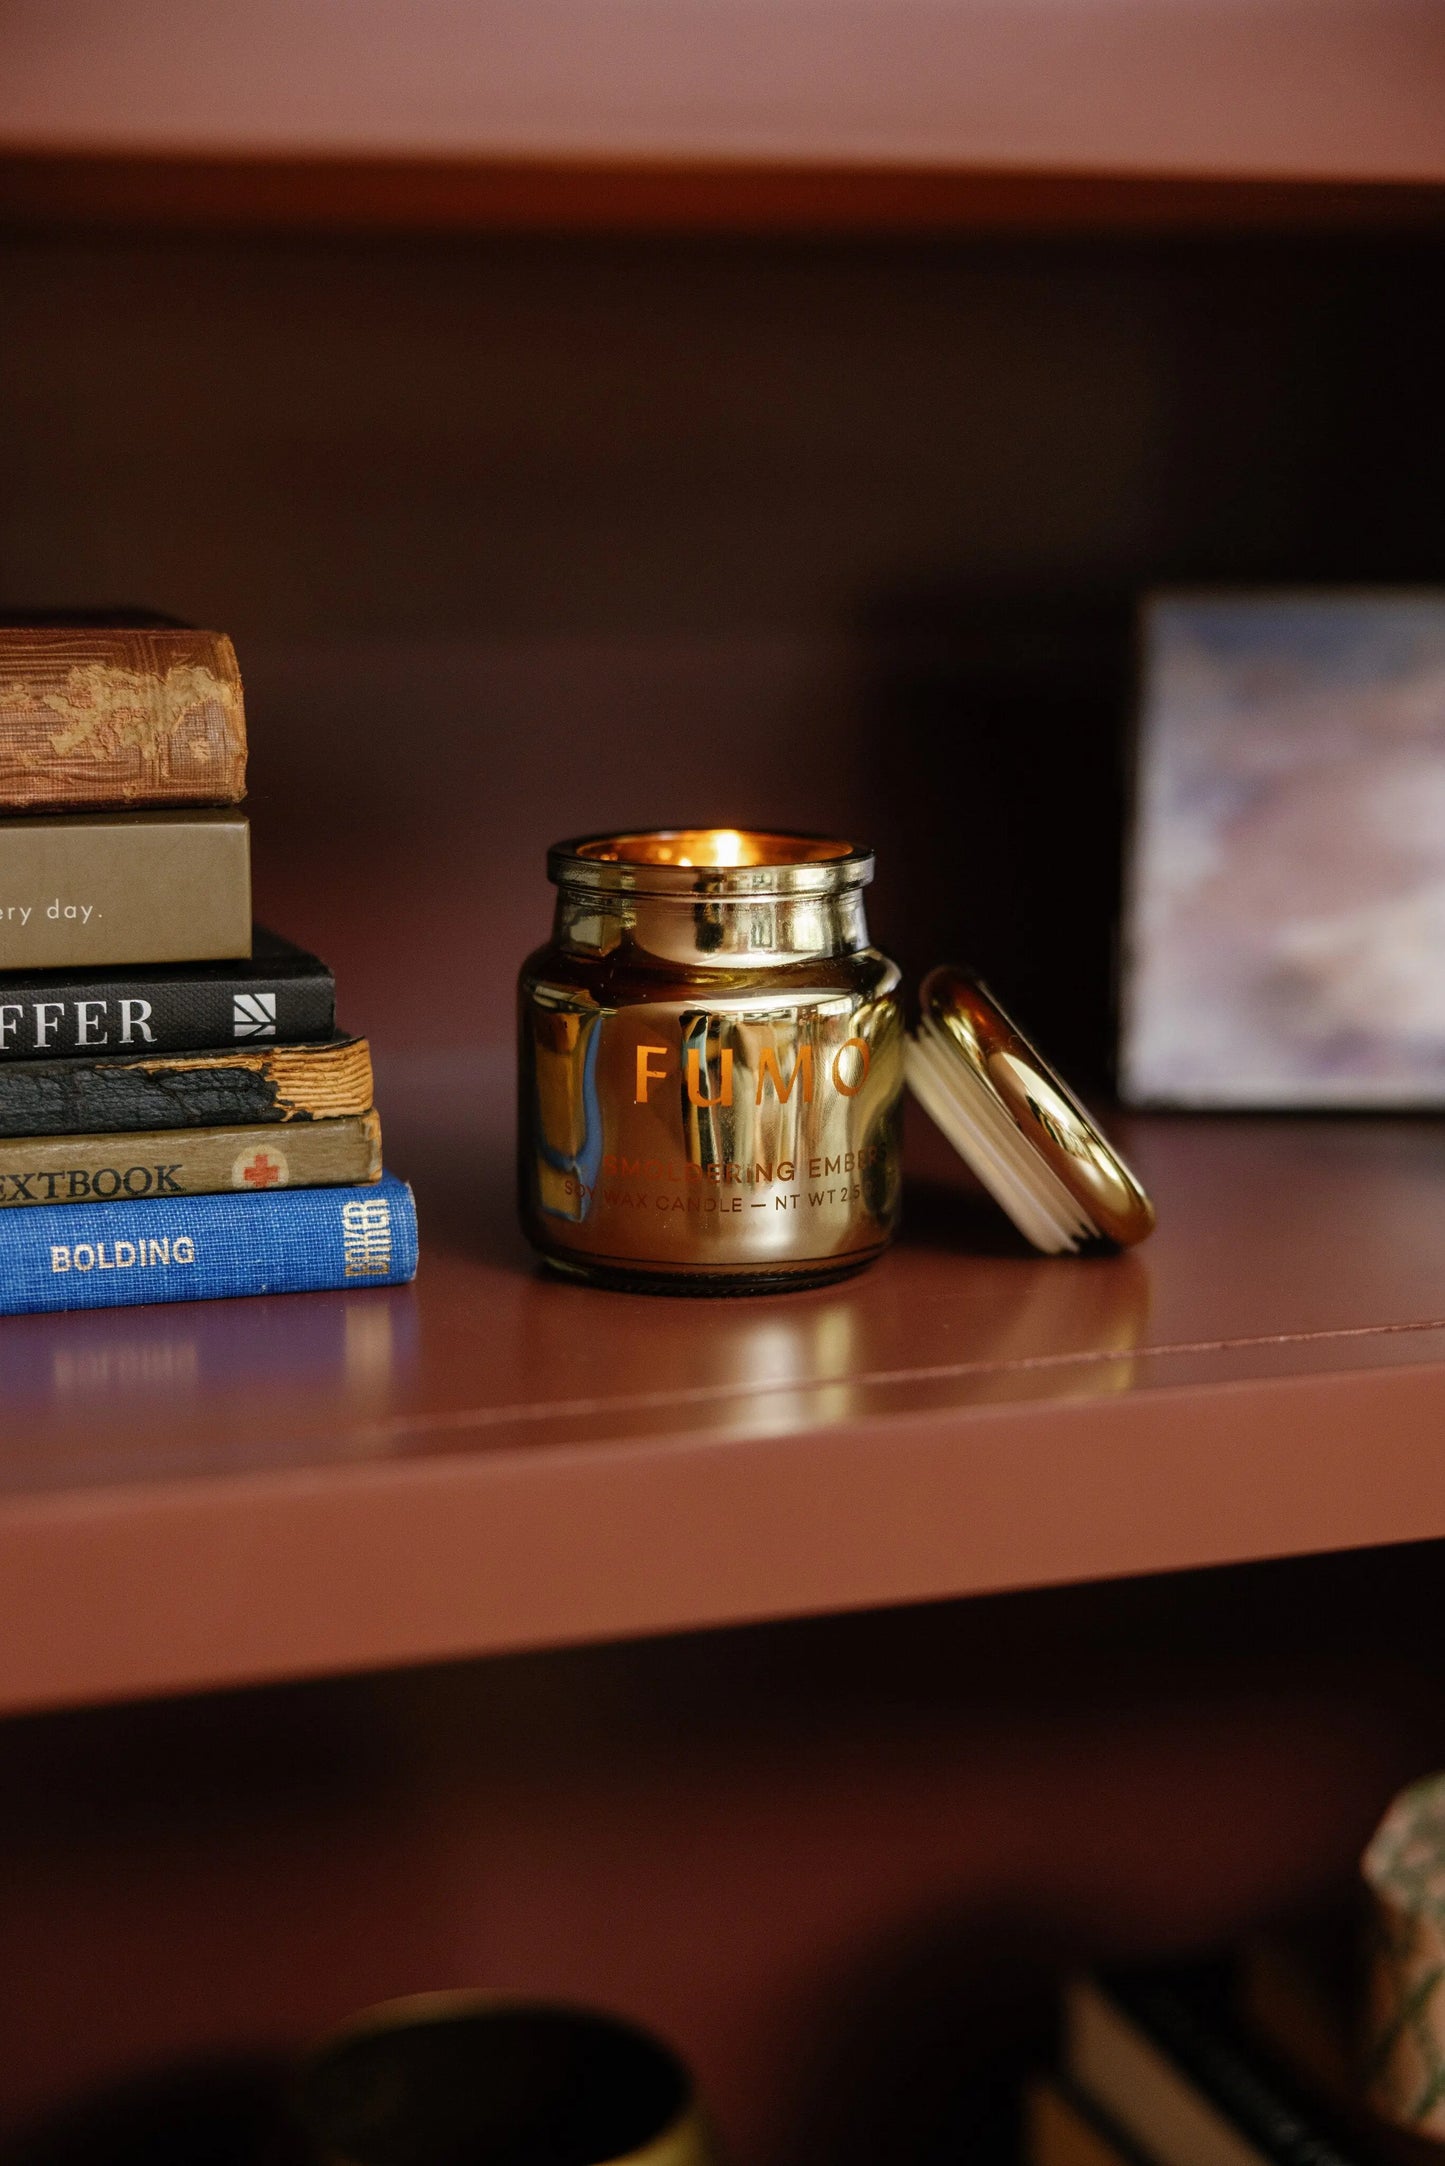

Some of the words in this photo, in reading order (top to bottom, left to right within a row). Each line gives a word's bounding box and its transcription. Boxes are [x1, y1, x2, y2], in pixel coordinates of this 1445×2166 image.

[46, 898, 103, 925] day.
[0, 999, 158, 1050] FFER
[635, 1037, 870, 1108] FUMO
[603, 1154, 795, 1185] SMOLDERING
[564, 1179, 598, 1202] SOY
[603, 1188, 648, 1210] WAX
[655, 1195, 742, 1213] CANDLE
[775, 1193, 800, 1211] NT
[808, 1189, 836, 1207] WT
[50, 1236, 195, 1273] BOLDING
[342, 1198, 392, 1277] BAKER
